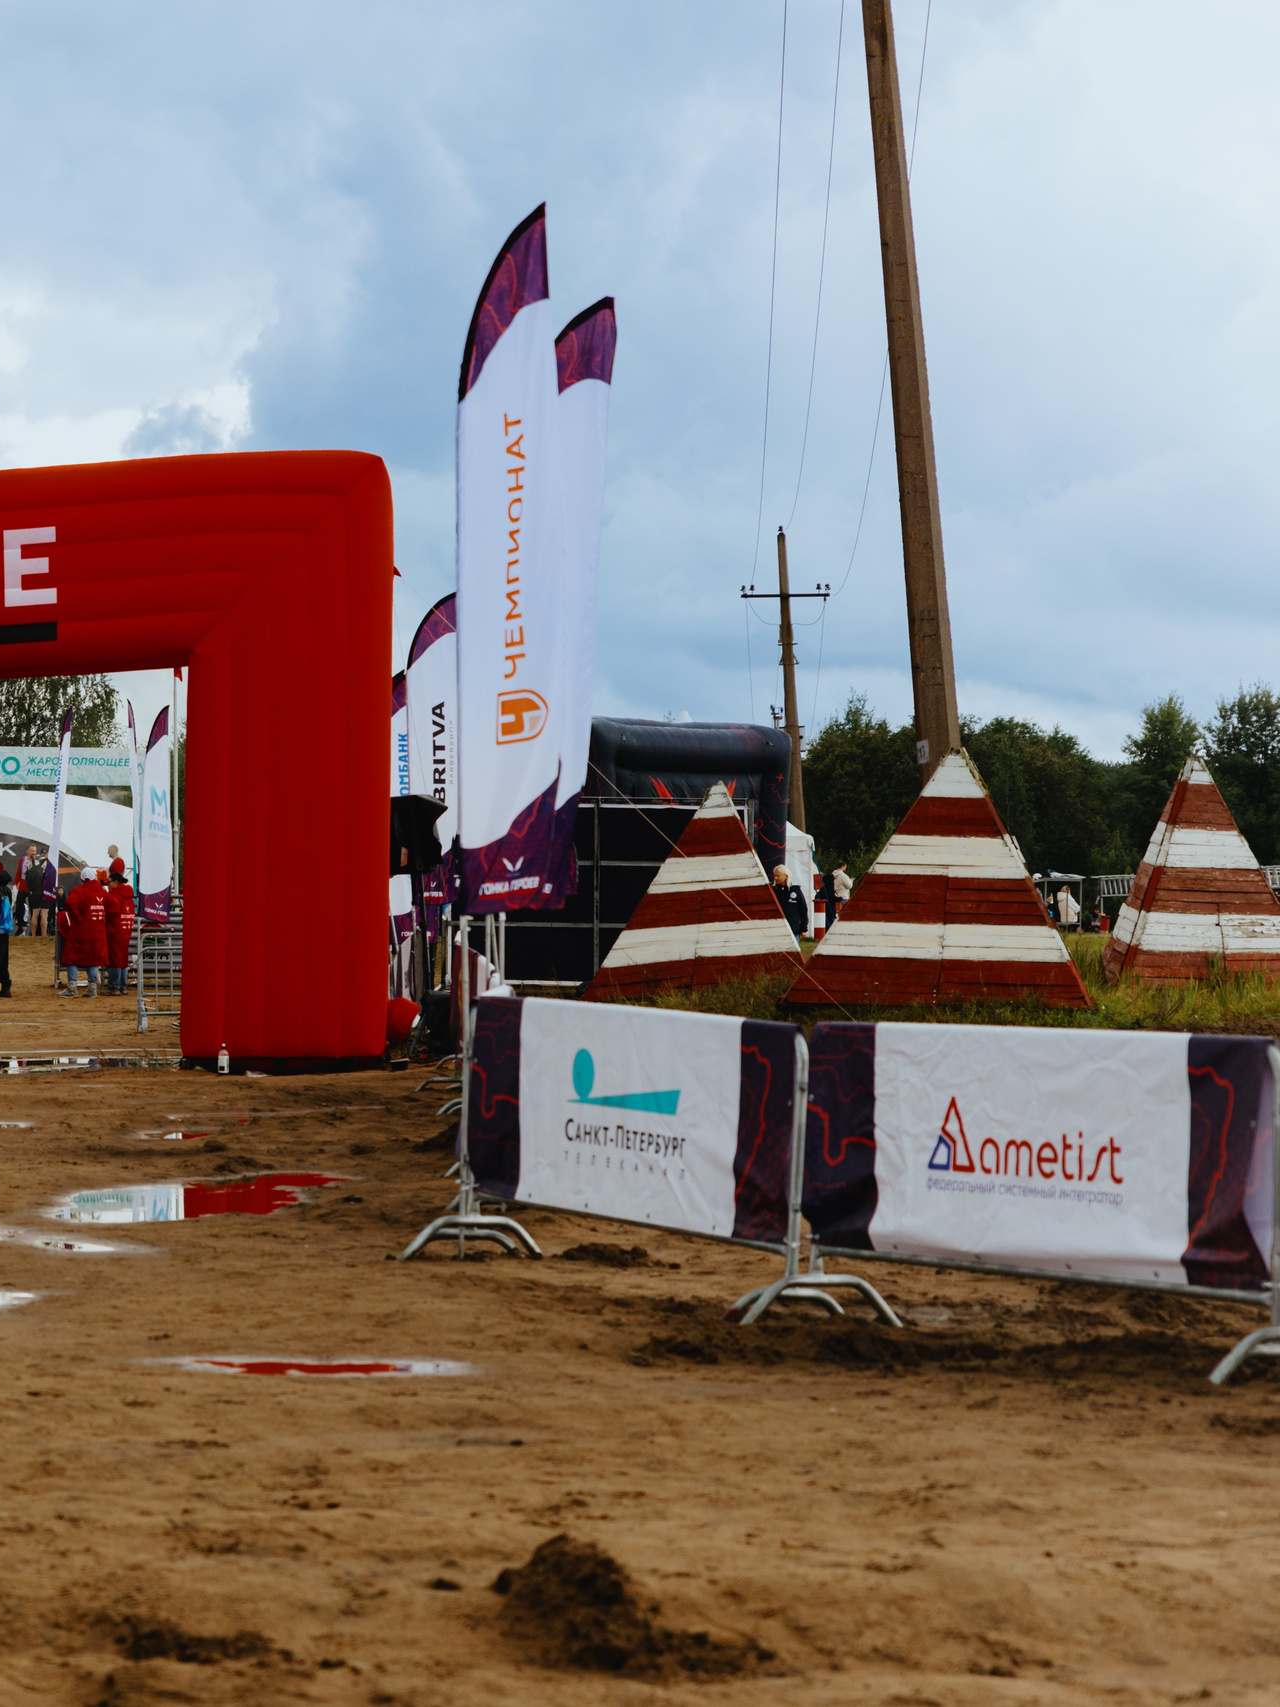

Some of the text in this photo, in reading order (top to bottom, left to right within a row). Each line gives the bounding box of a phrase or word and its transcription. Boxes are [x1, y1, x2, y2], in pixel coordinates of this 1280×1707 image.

[503, 413, 526, 680] ЧЕМПИОНАТ
[25, 755, 130, 767] ЖАРОТОЛЯЮЩЕЕ
[397, 732, 409, 797] ОМБАНК
[431, 701, 446, 804] BRITVA
[478, 881, 509, 896] ГОНКА
[979, 1130, 1124, 1185] ametist
